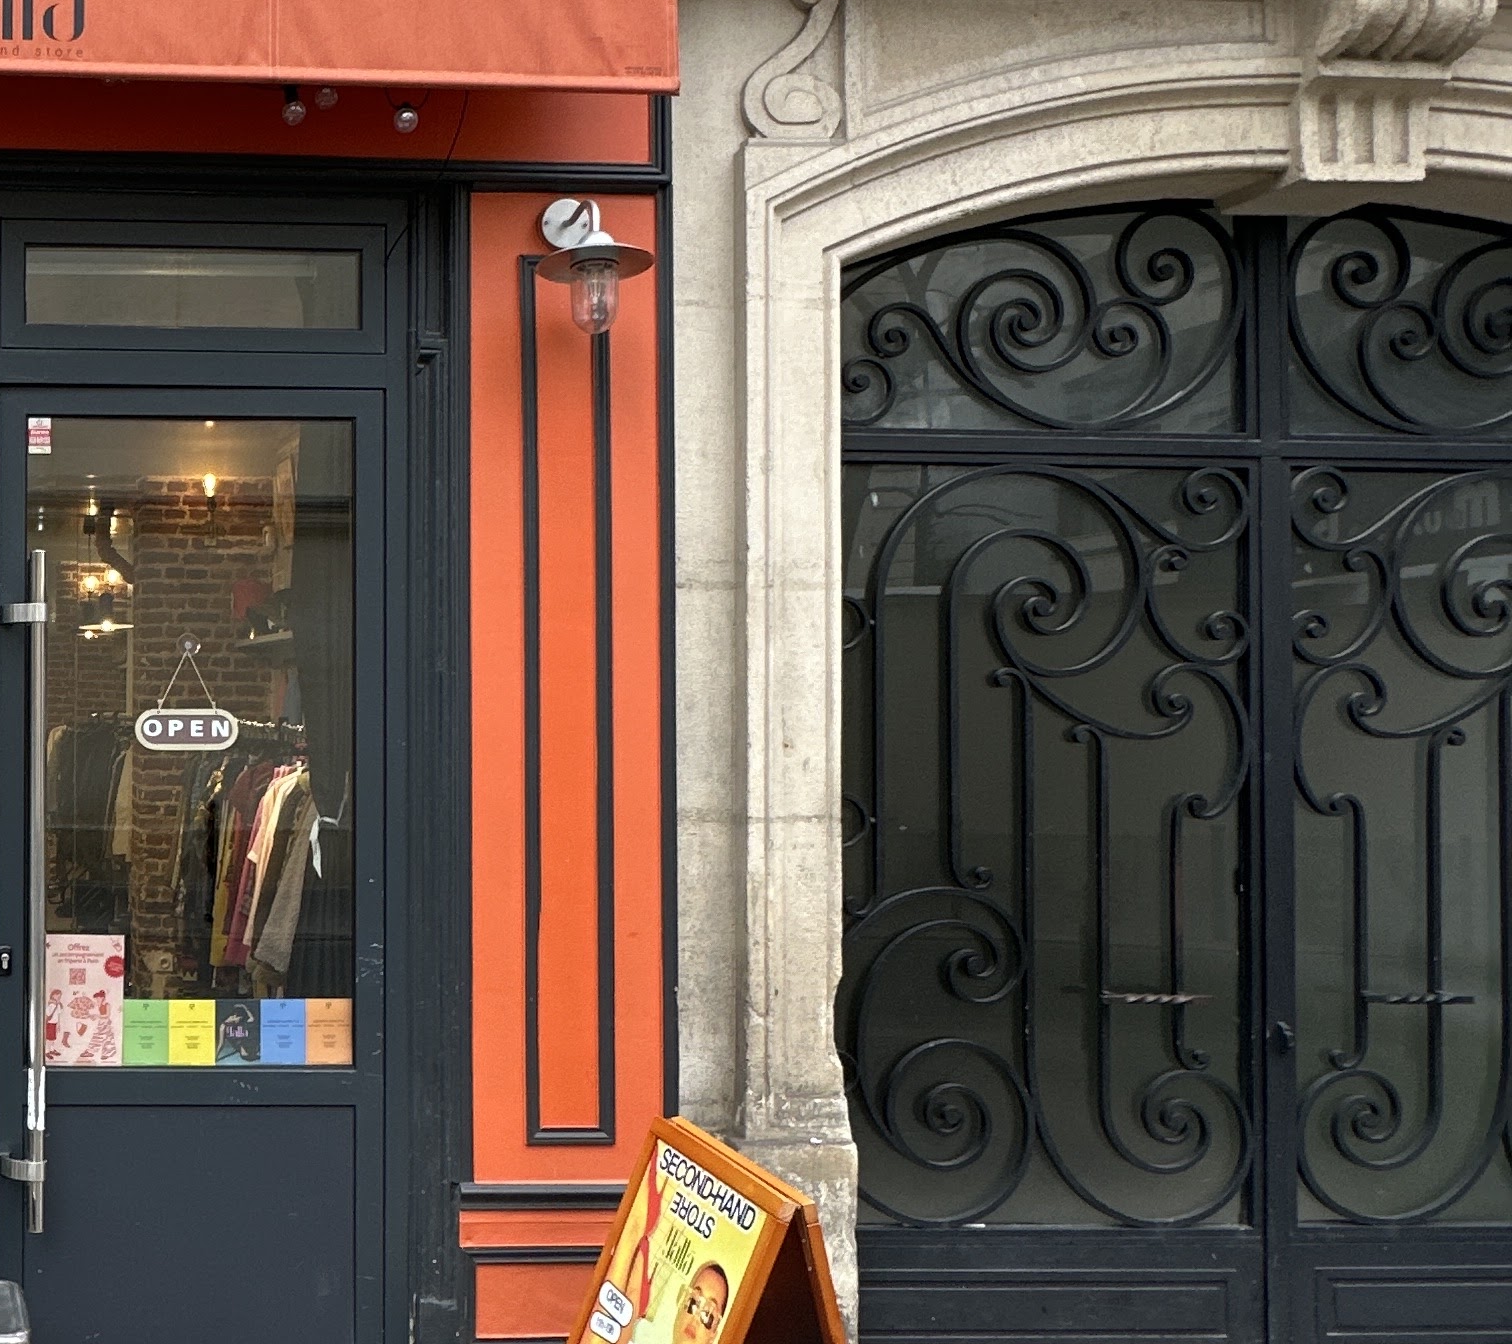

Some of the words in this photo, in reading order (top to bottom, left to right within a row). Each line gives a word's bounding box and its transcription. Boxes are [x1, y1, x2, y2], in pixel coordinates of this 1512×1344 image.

[34, 45, 84, 57] store
[142, 718, 230, 738] OPEN
[659, 1148, 756, 1231] SECOND-HAND
[669, 1191, 716, 1239] STORE
[606, 1288, 626, 1314] OPEN
